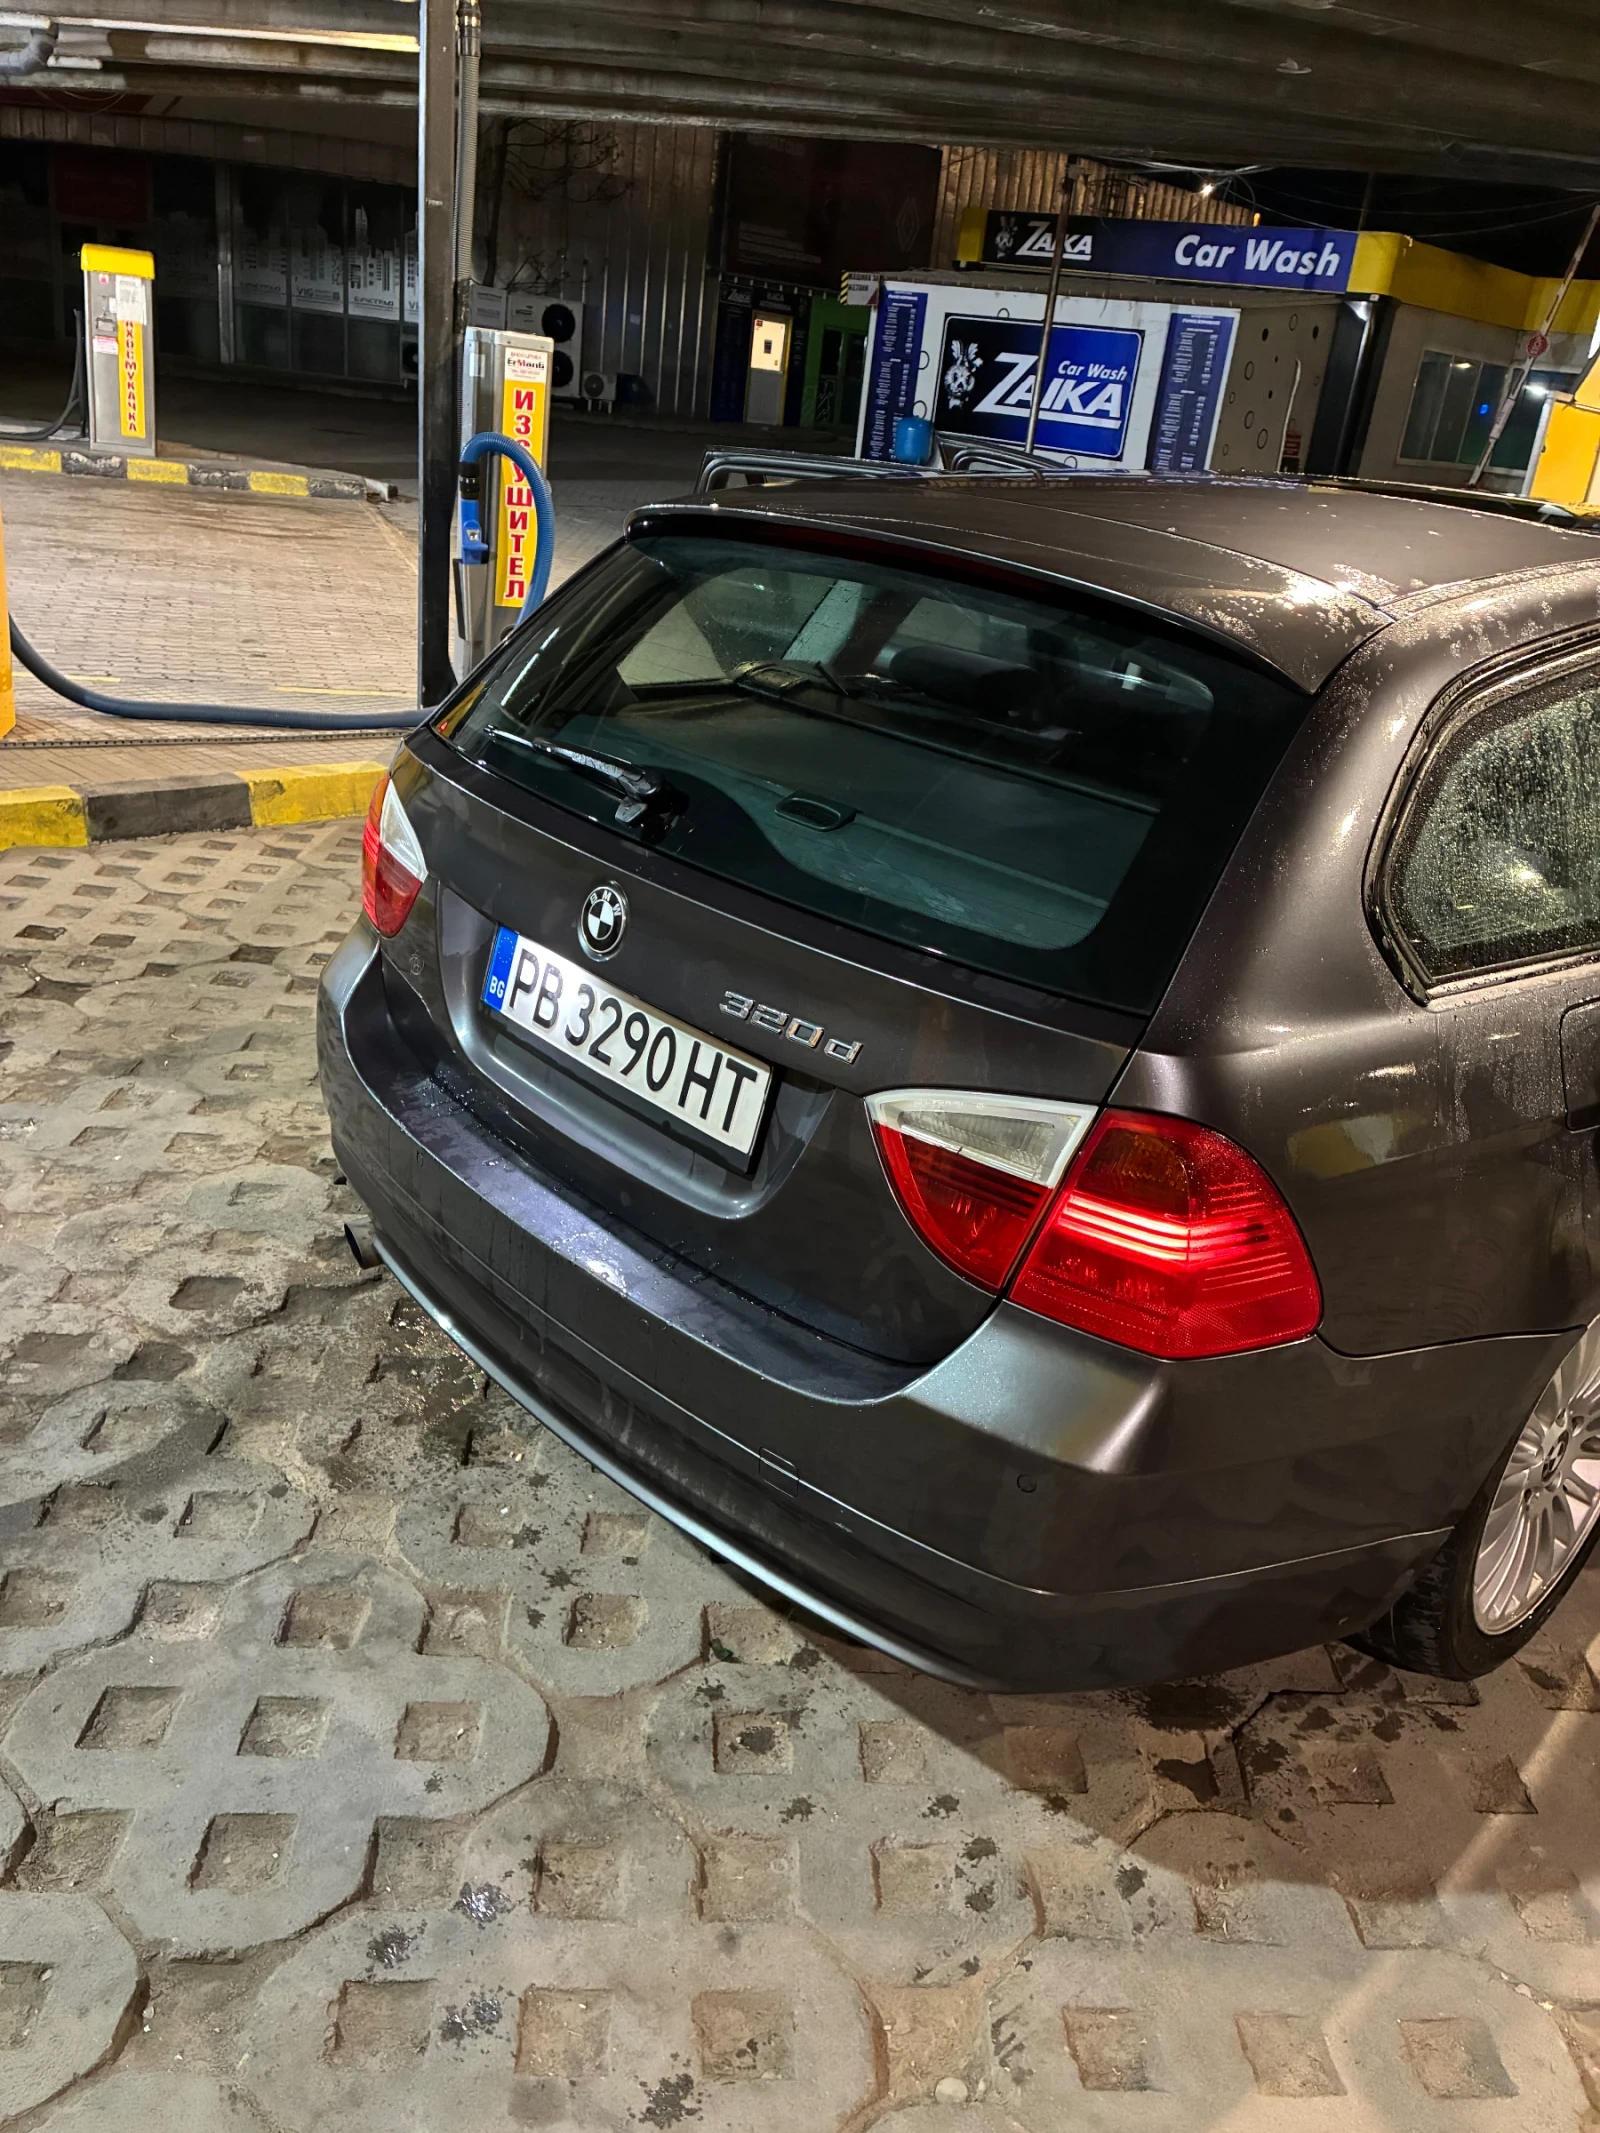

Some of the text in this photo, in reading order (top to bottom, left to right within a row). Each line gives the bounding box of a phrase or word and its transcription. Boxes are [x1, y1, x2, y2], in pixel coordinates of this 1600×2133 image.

[1174, 234, 1341, 277] Car Wash
[972, 352, 1123, 430] ZAIKA
[1057, 360, 1128, 381] Car Wash
[489, 975, 505, 999] BG
[508, 947, 758, 1133] PB 3290 HT
